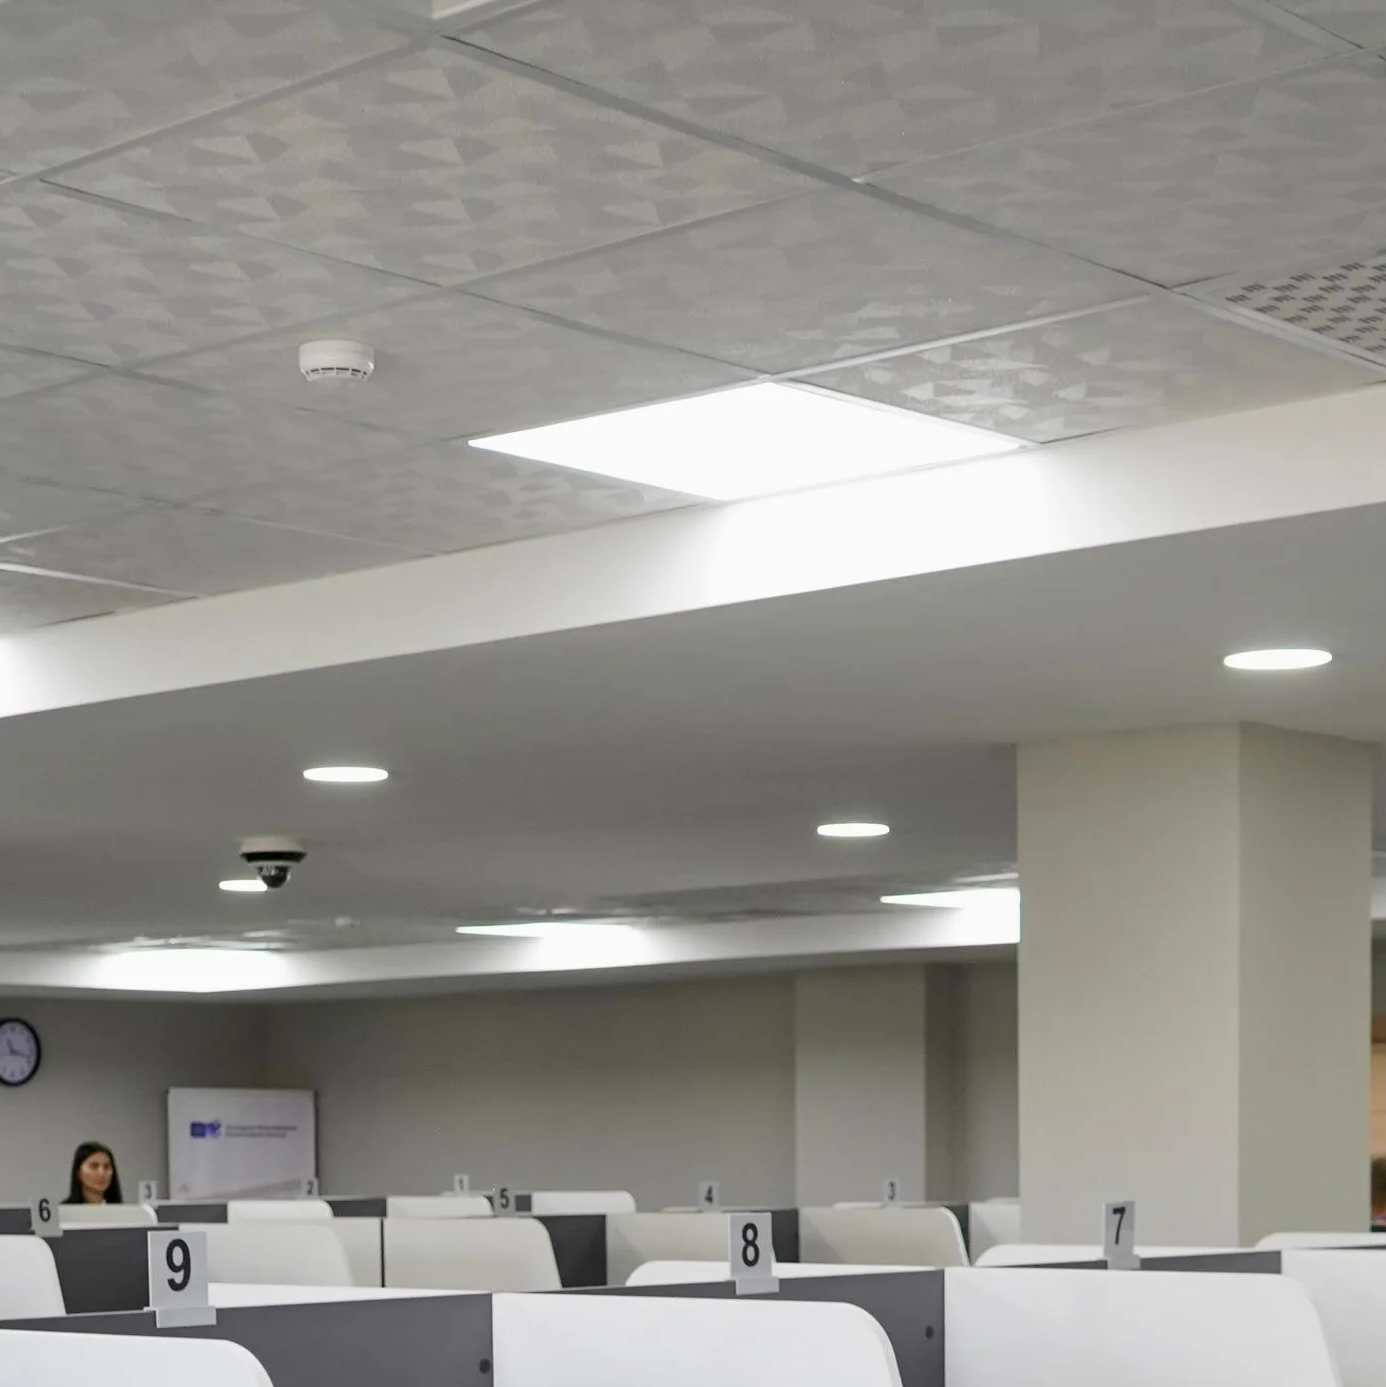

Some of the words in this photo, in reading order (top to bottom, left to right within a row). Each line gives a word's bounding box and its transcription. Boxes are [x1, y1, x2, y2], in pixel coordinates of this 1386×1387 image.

[38, 1198, 51, 1222] 6
[500, 1187, 510, 1209] 5
[740, 1222, 760, 1267] 8
[1112, 1205, 1126, 1245] 7
[165, 1237, 191, 1292] 9
